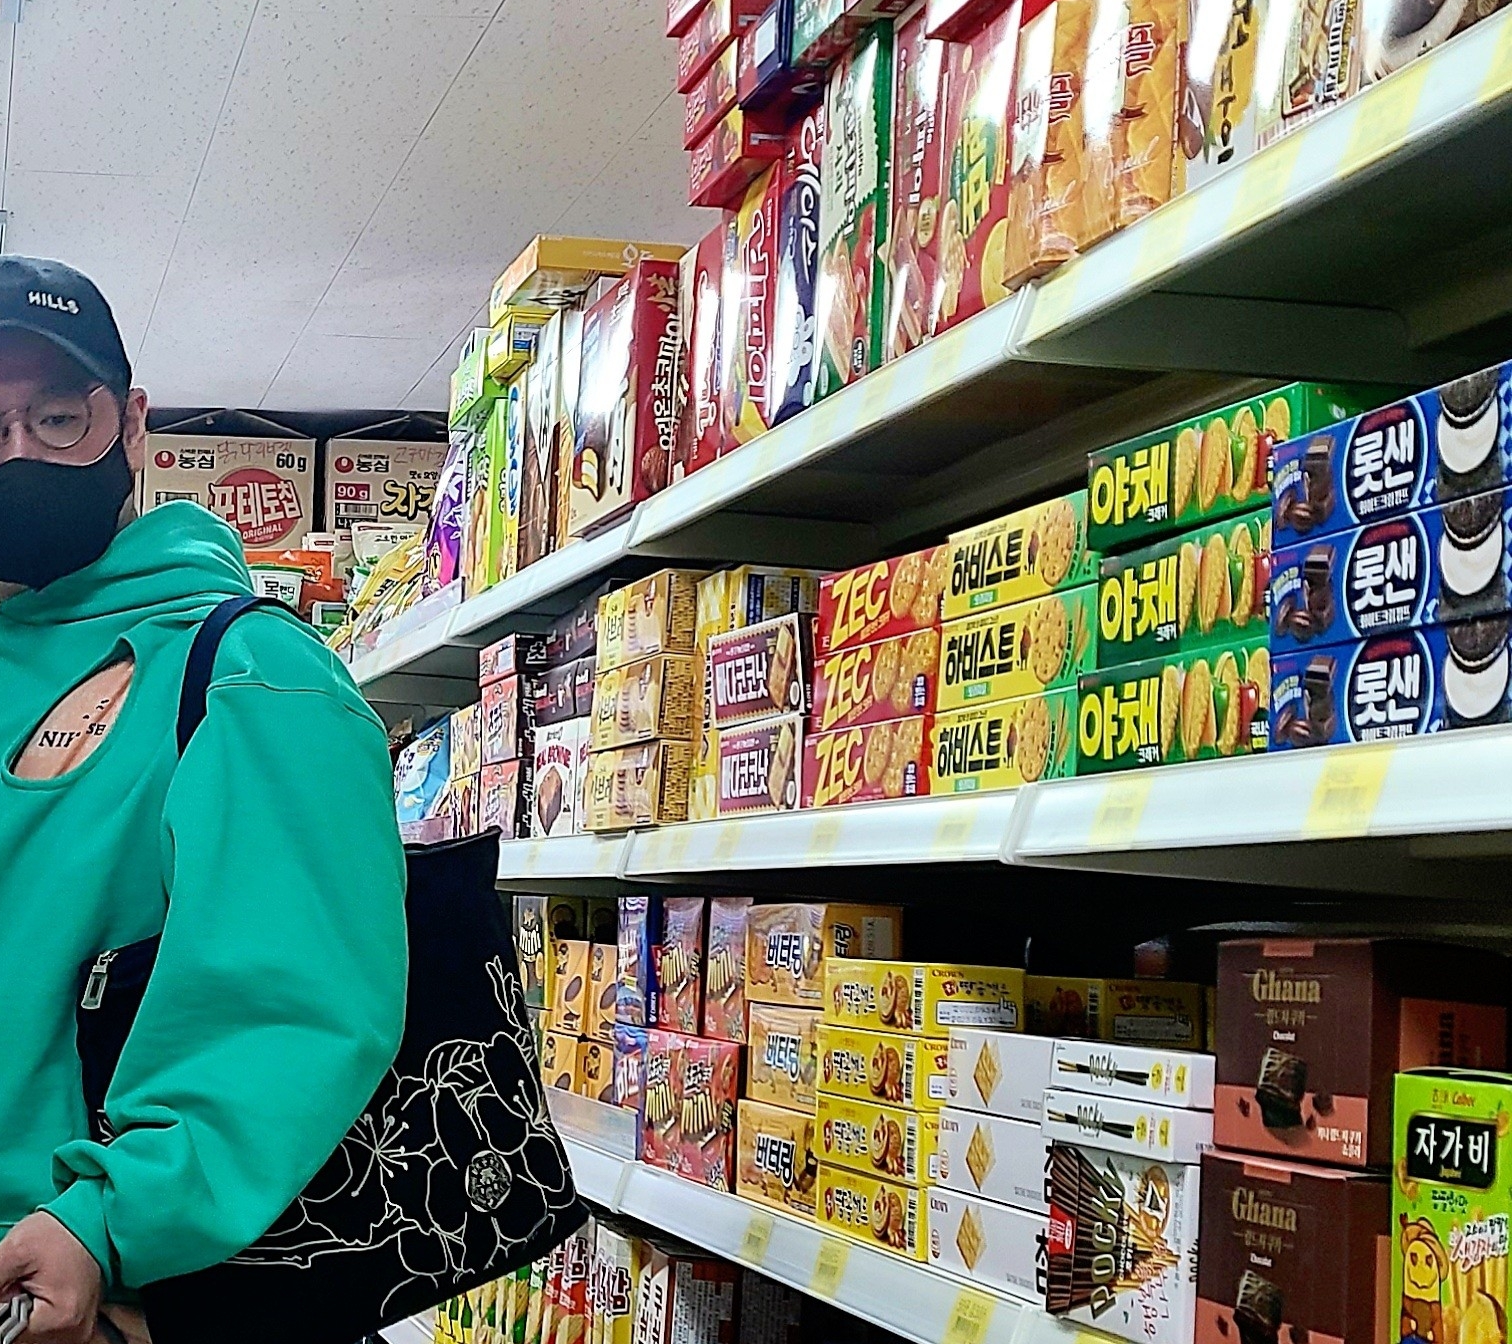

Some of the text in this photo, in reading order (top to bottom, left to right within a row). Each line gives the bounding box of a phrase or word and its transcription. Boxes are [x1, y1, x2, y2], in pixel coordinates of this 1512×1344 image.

[27, 291, 80, 315] HILLS
[179, 454, 216, 469] 농심
[356, 458, 390, 473] 농심
[1092, 440, 1170, 528] 야채
[1353, 420, 1414, 494] 롯샌
[209, 479, 303, 529] 포테토칩
[242, 523, 284, 541] ORIGINAL
[951, 529, 1023, 594] 하비스트
[1353, 540, 1415, 612] 롯샌
[829, 562, 889, 652] ZEC
[1099, 555, 1178, 645] 야채
[944, 621, 1016, 687] 하비스트
[822, 643, 872, 732] ZEC
[1355, 654, 1421, 726] 롯샌
[1078, 676, 1161, 761] 야채
[814, 727, 864, 808] ZEC
[936, 718, 1004, 778] 하비스트
[766, 931, 804, 979] 버터링
[932, 968, 965, 980] CROWN
[1251, 967, 1325, 1006] Ghana
[765, 1029, 804, 1083] 버터링
[755, 1132, 796, 1188] 버터링
[1414, 1122, 1491, 1175] 자가비
[1231, 1186, 1298, 1234] Ghana
